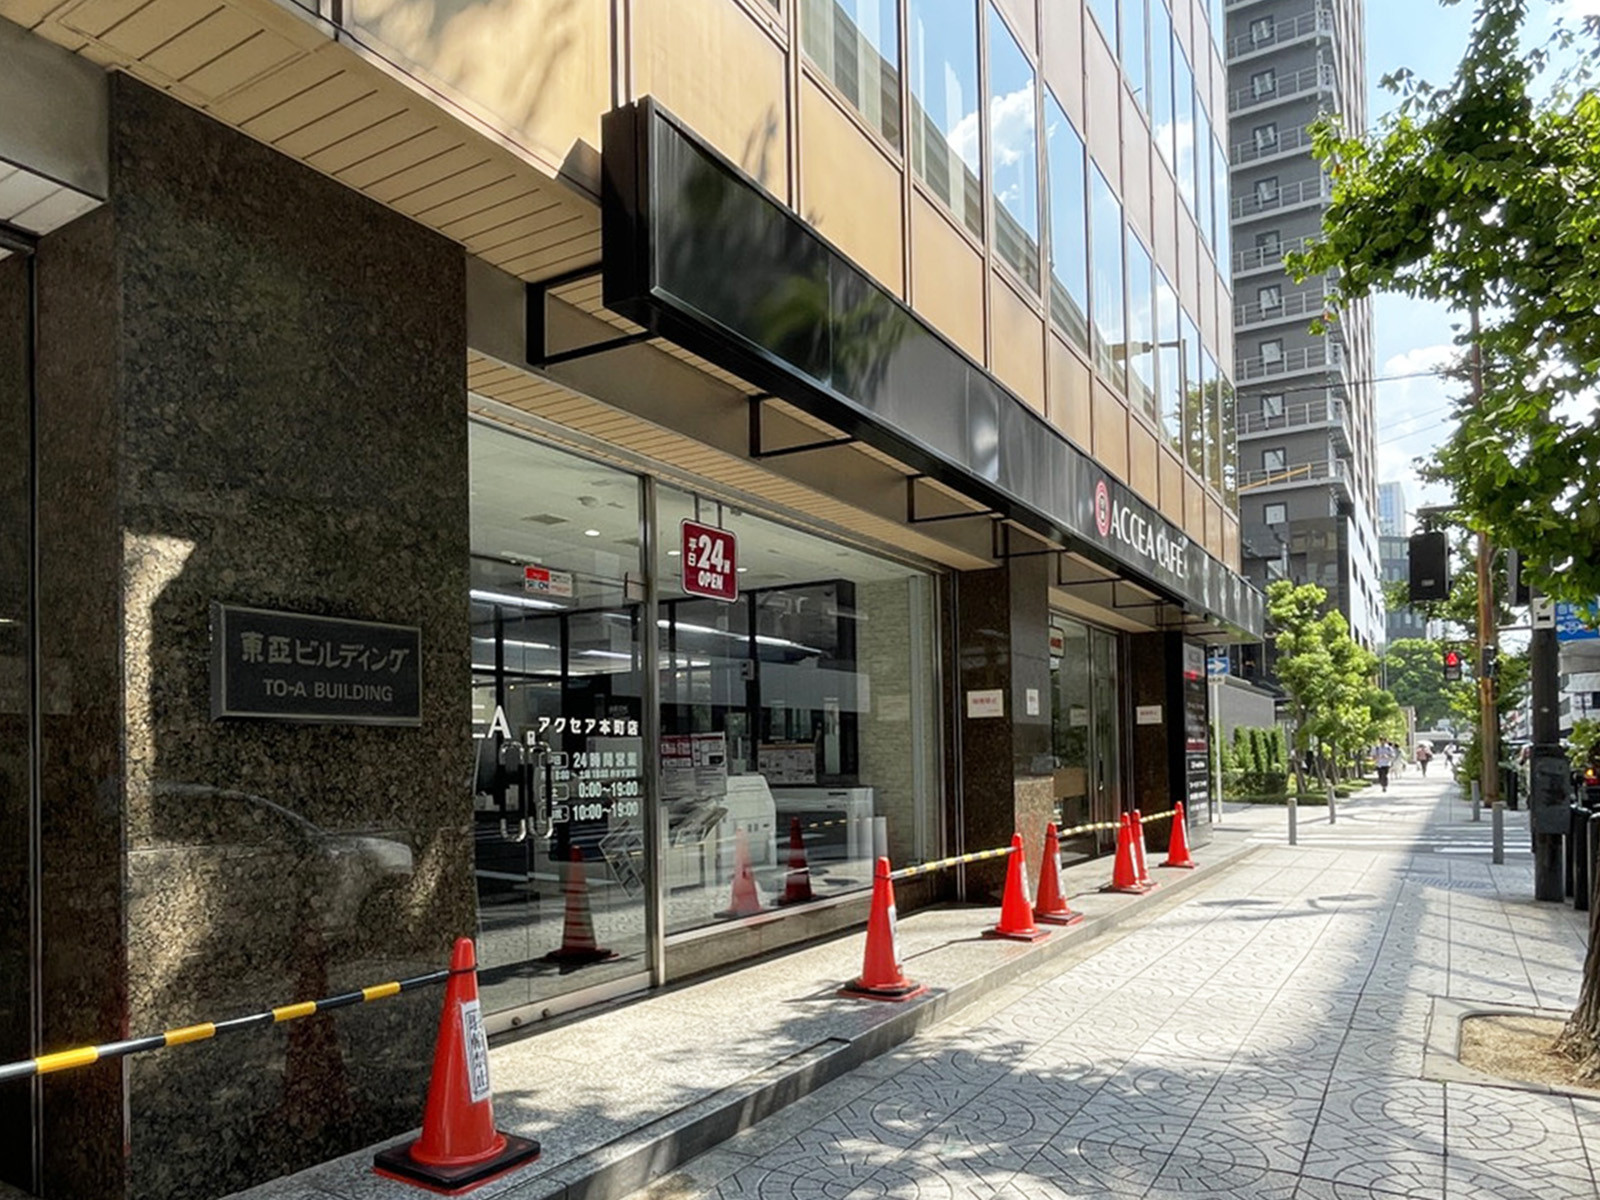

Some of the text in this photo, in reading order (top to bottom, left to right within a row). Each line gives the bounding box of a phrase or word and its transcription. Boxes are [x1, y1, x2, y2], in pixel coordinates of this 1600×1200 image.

[1110, 499, 1155, 560] ACCEA
[688, 537, 697, 567] 平日
[698, 570, 723, 590] OPEN
[241, 631, 409, 673] 東亞ビルディング
[263, 679, 393, 701] TO-A BUILDING
[538, 717, 639, 736] アクセア本町店
